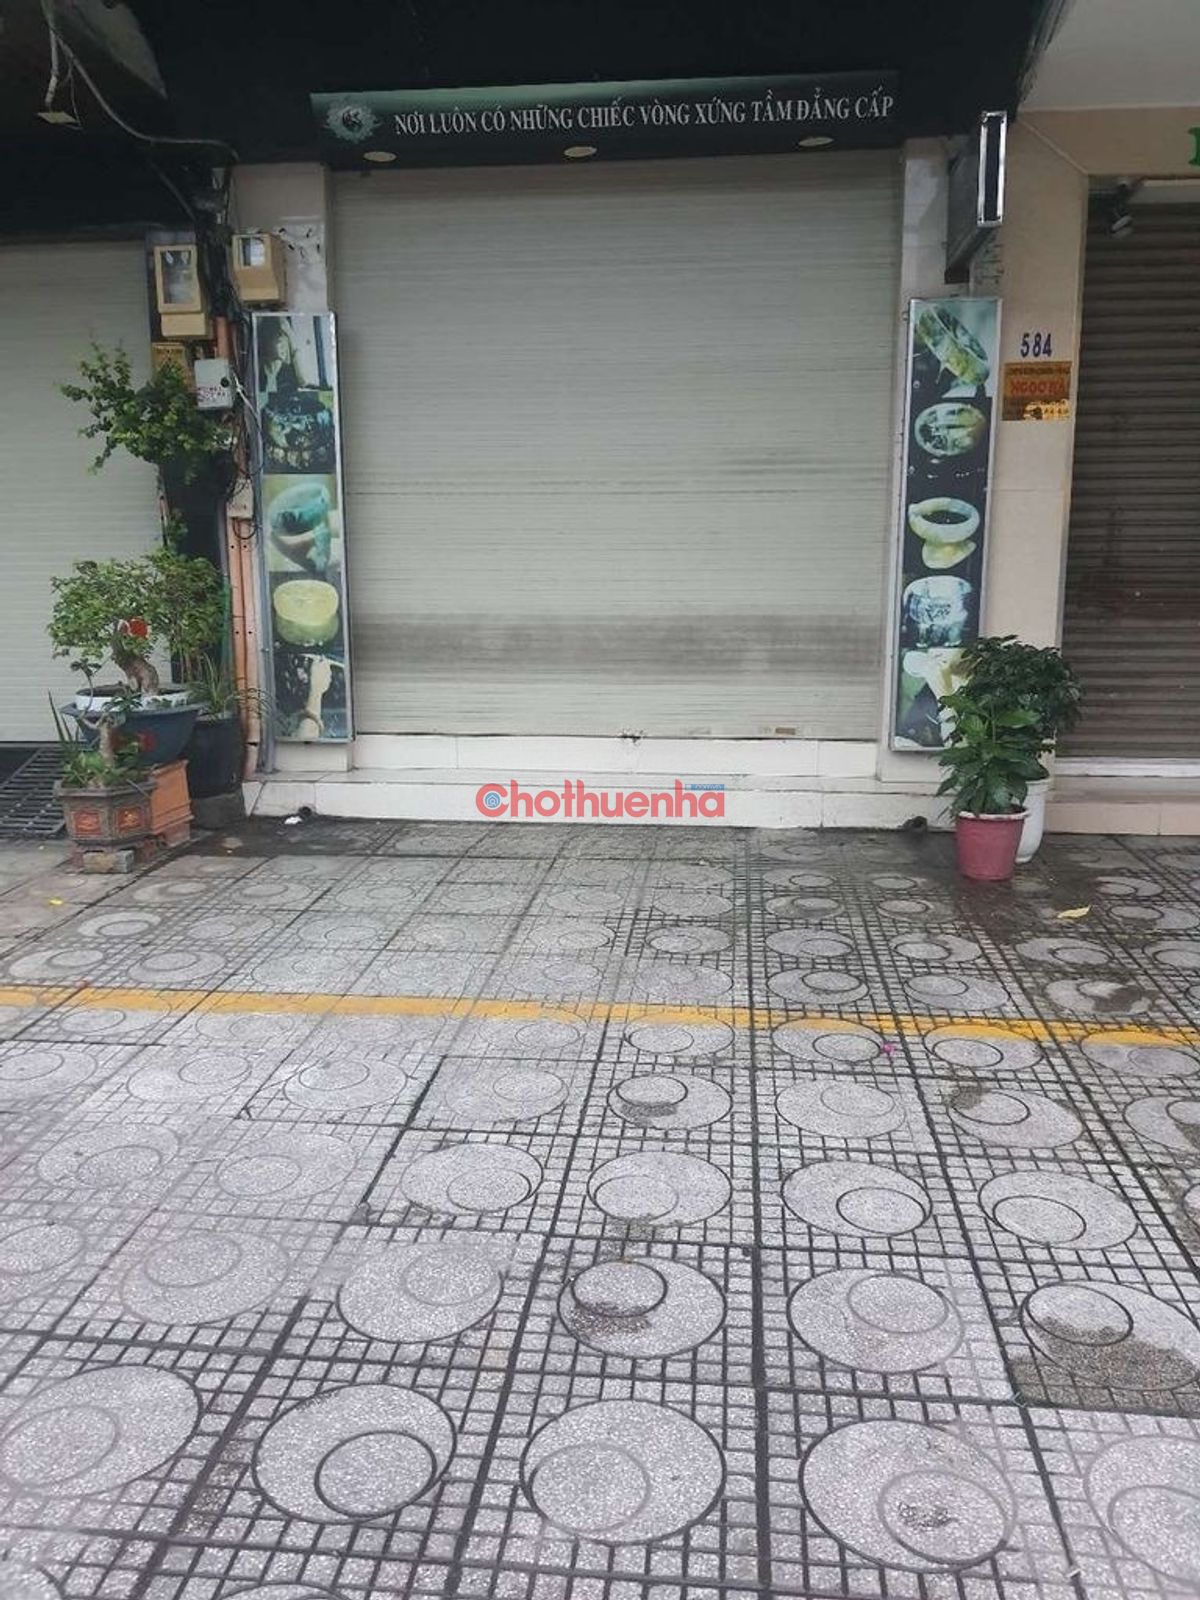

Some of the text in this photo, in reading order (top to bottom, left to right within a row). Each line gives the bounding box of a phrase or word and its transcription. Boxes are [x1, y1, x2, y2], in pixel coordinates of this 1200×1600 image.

[395, 85, 894, 135] NƠI LUÔN CÓ NHỮNG CHIẾC VÒNG XỨNG TẦM ĐẲNG CẤP
[1020, 332, 1053, 358] 584
